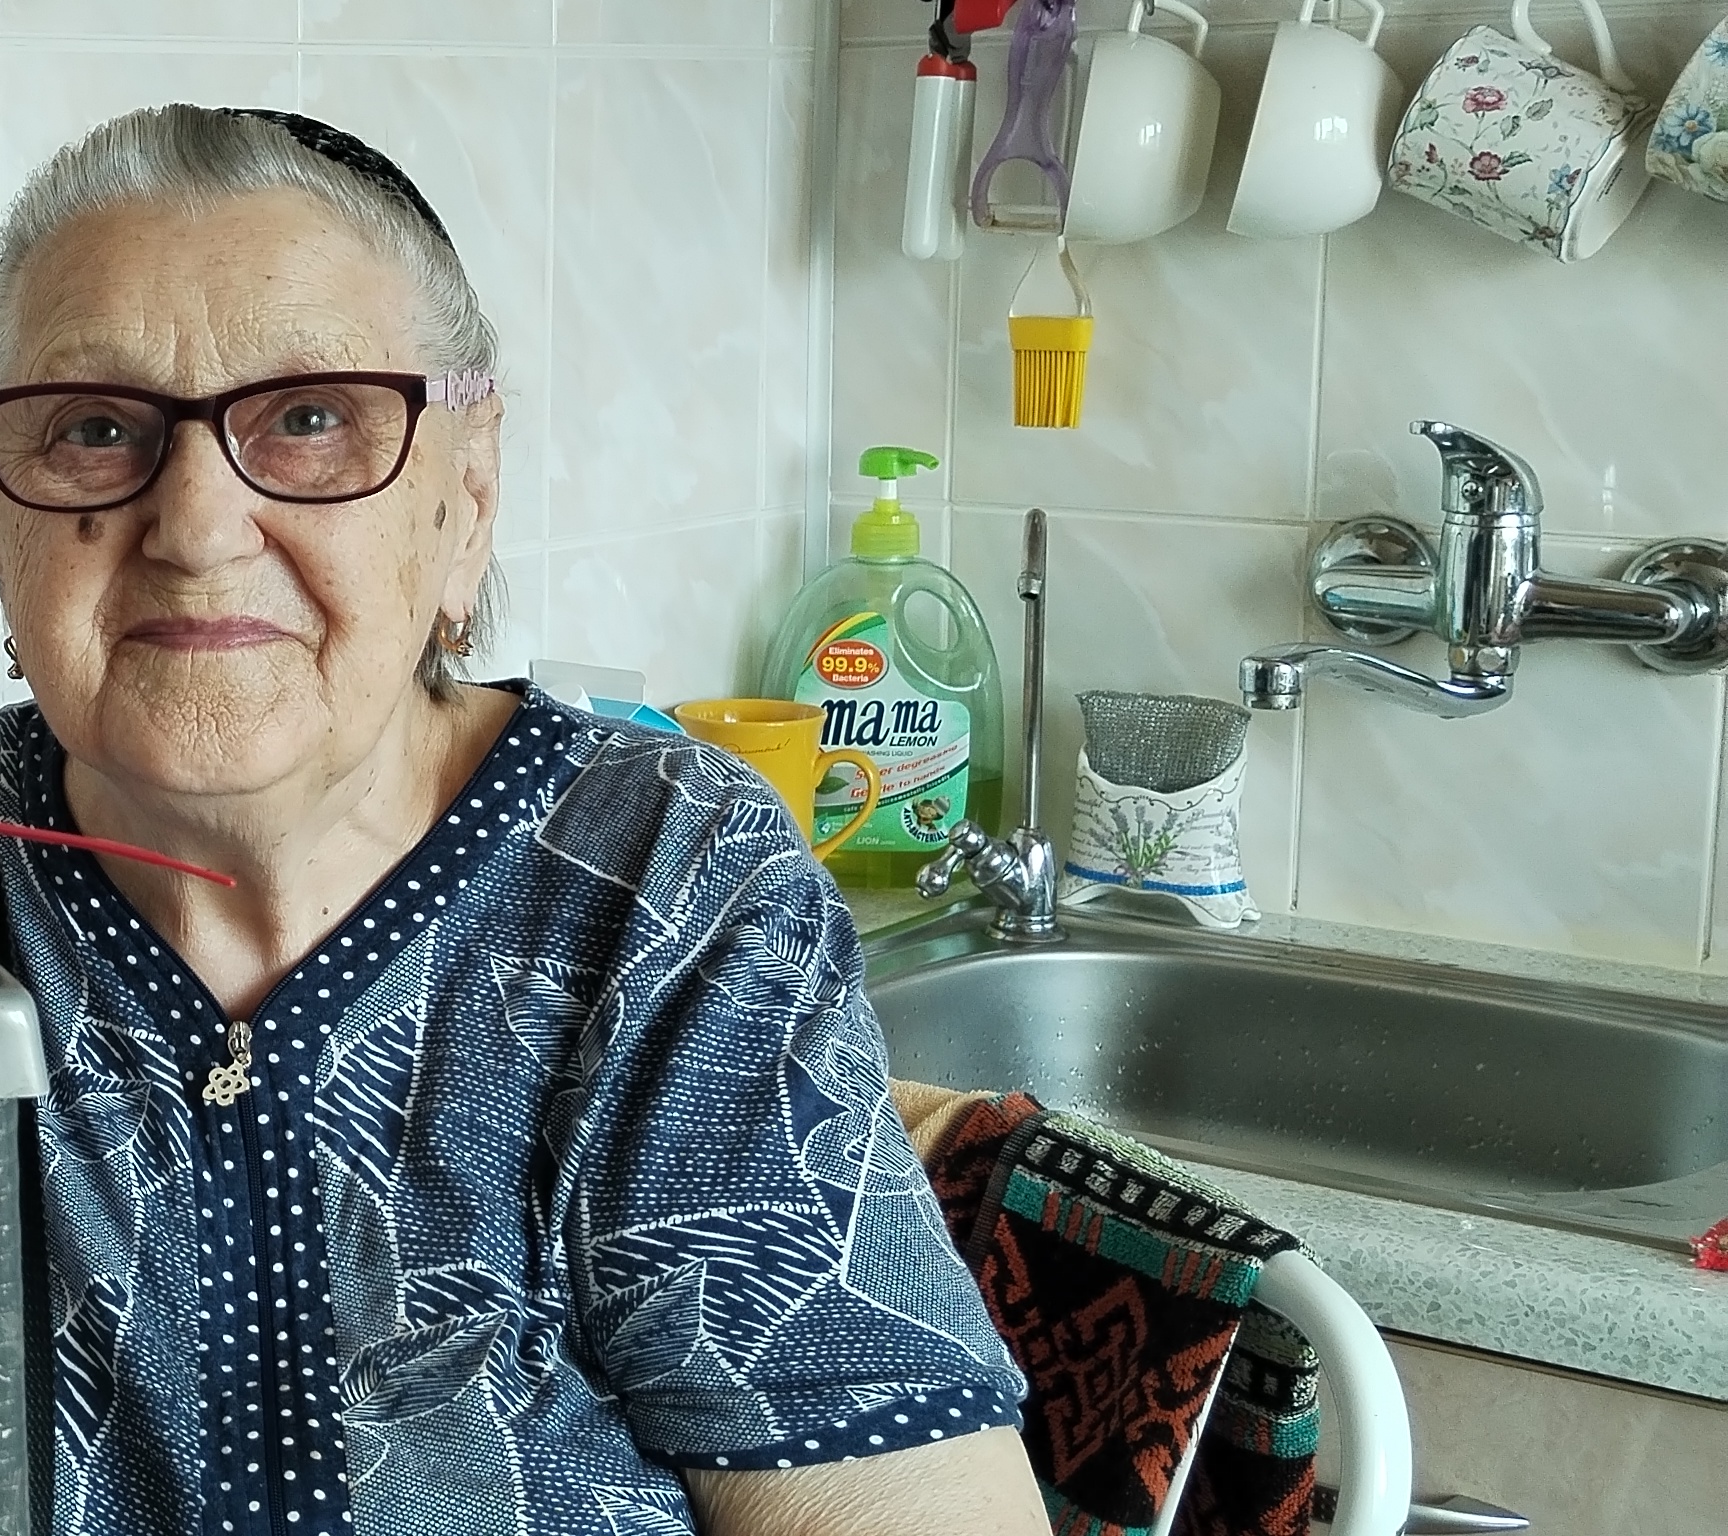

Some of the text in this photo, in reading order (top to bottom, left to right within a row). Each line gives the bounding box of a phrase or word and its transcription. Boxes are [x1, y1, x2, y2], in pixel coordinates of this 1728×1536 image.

[828, 647, 874, 656] Eliminates
[822, 656, 880, 674] 99.9%
[832, 674, 869, 683] Bacteria
[889, 736, 938, 747] LEMON
